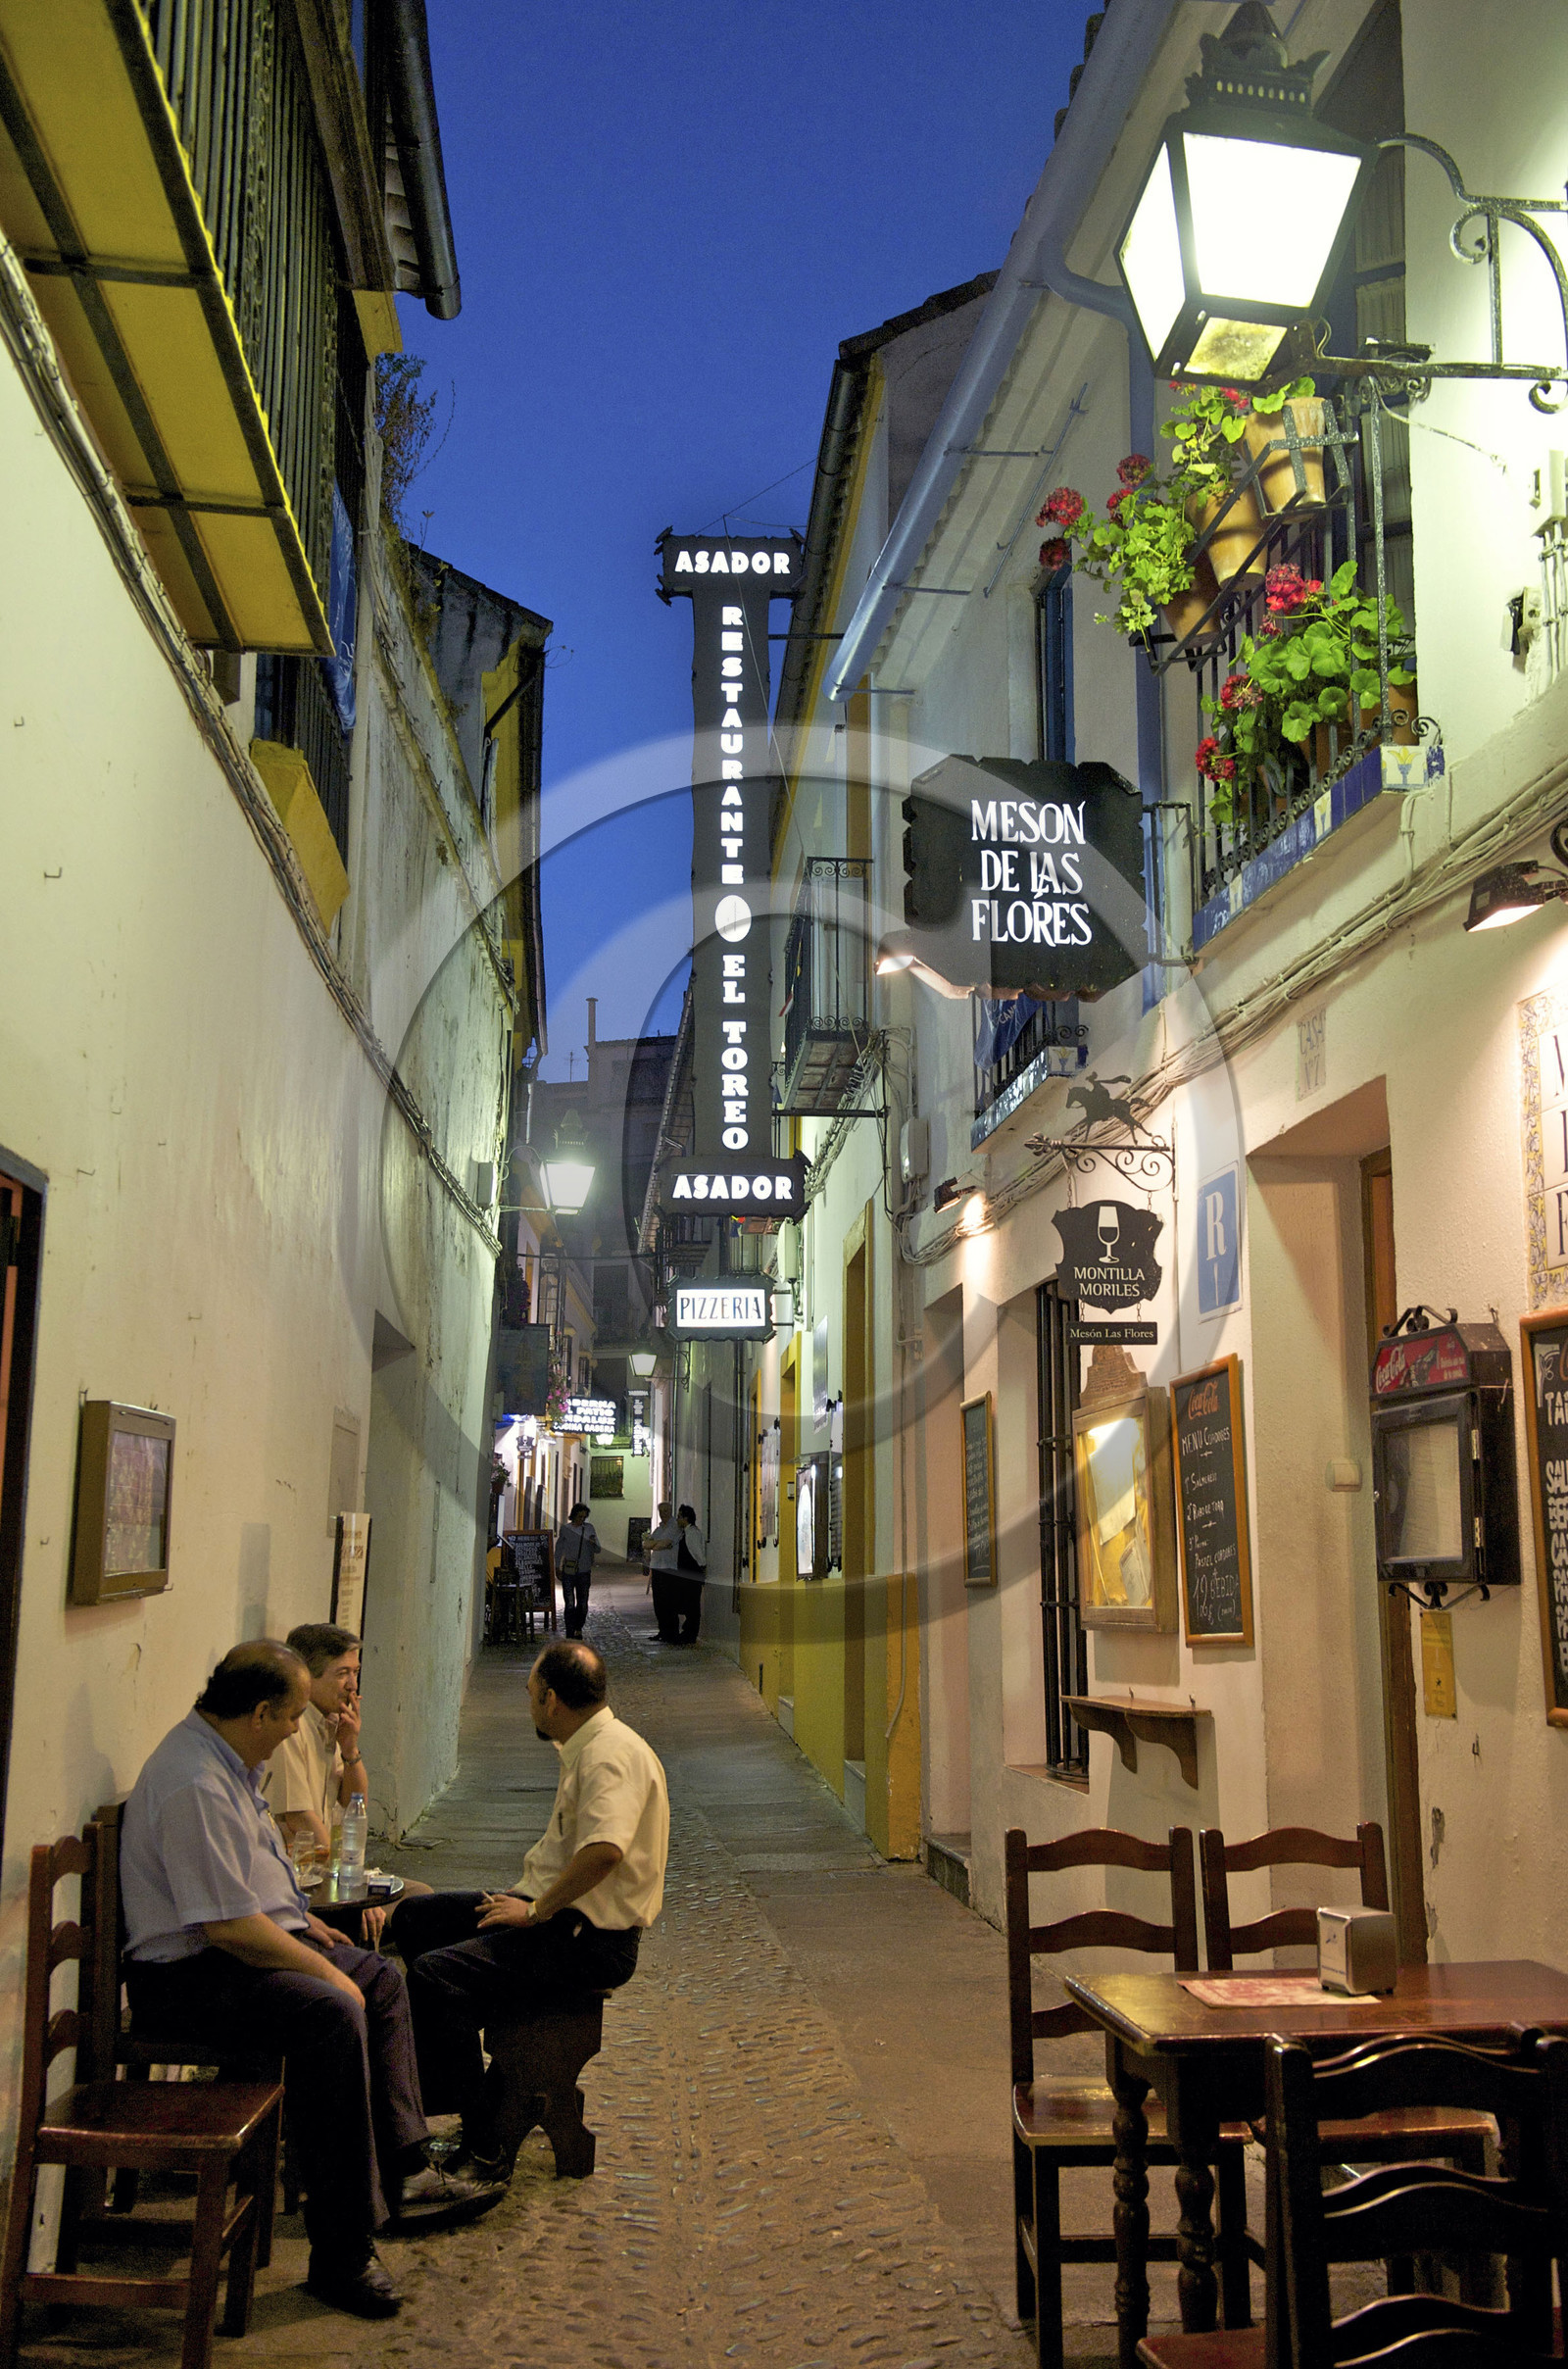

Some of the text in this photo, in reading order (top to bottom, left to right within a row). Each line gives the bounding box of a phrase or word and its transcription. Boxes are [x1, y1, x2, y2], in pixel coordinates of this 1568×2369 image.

[674, 550, 791, 574] ASADOR
[720, 606, 744, 885] RESTAURANTE
[970, 800, 1086, 845] MESON
[980, 849, 1083, 900] DE LAS
[970, 899, 1093, 947] FLORES
[721, 955, 749, 1150] EL TOREO
[672, 1175, 793, 1201] ASADOR
[1205, 1191, 1227, 1261] R
[1074, 1266, 1146, 1282] MONTILLA
[1079, 1282, 1141, 1298] MORILES
[680, 1296, 761, 1320] PIZZERIA
[1070, 1327, 1154, 1339] Mesón Las Flores
[565, 1399, 616, 1409] ABERNA
[562, 1414, 615, 1425] NDALUZ
